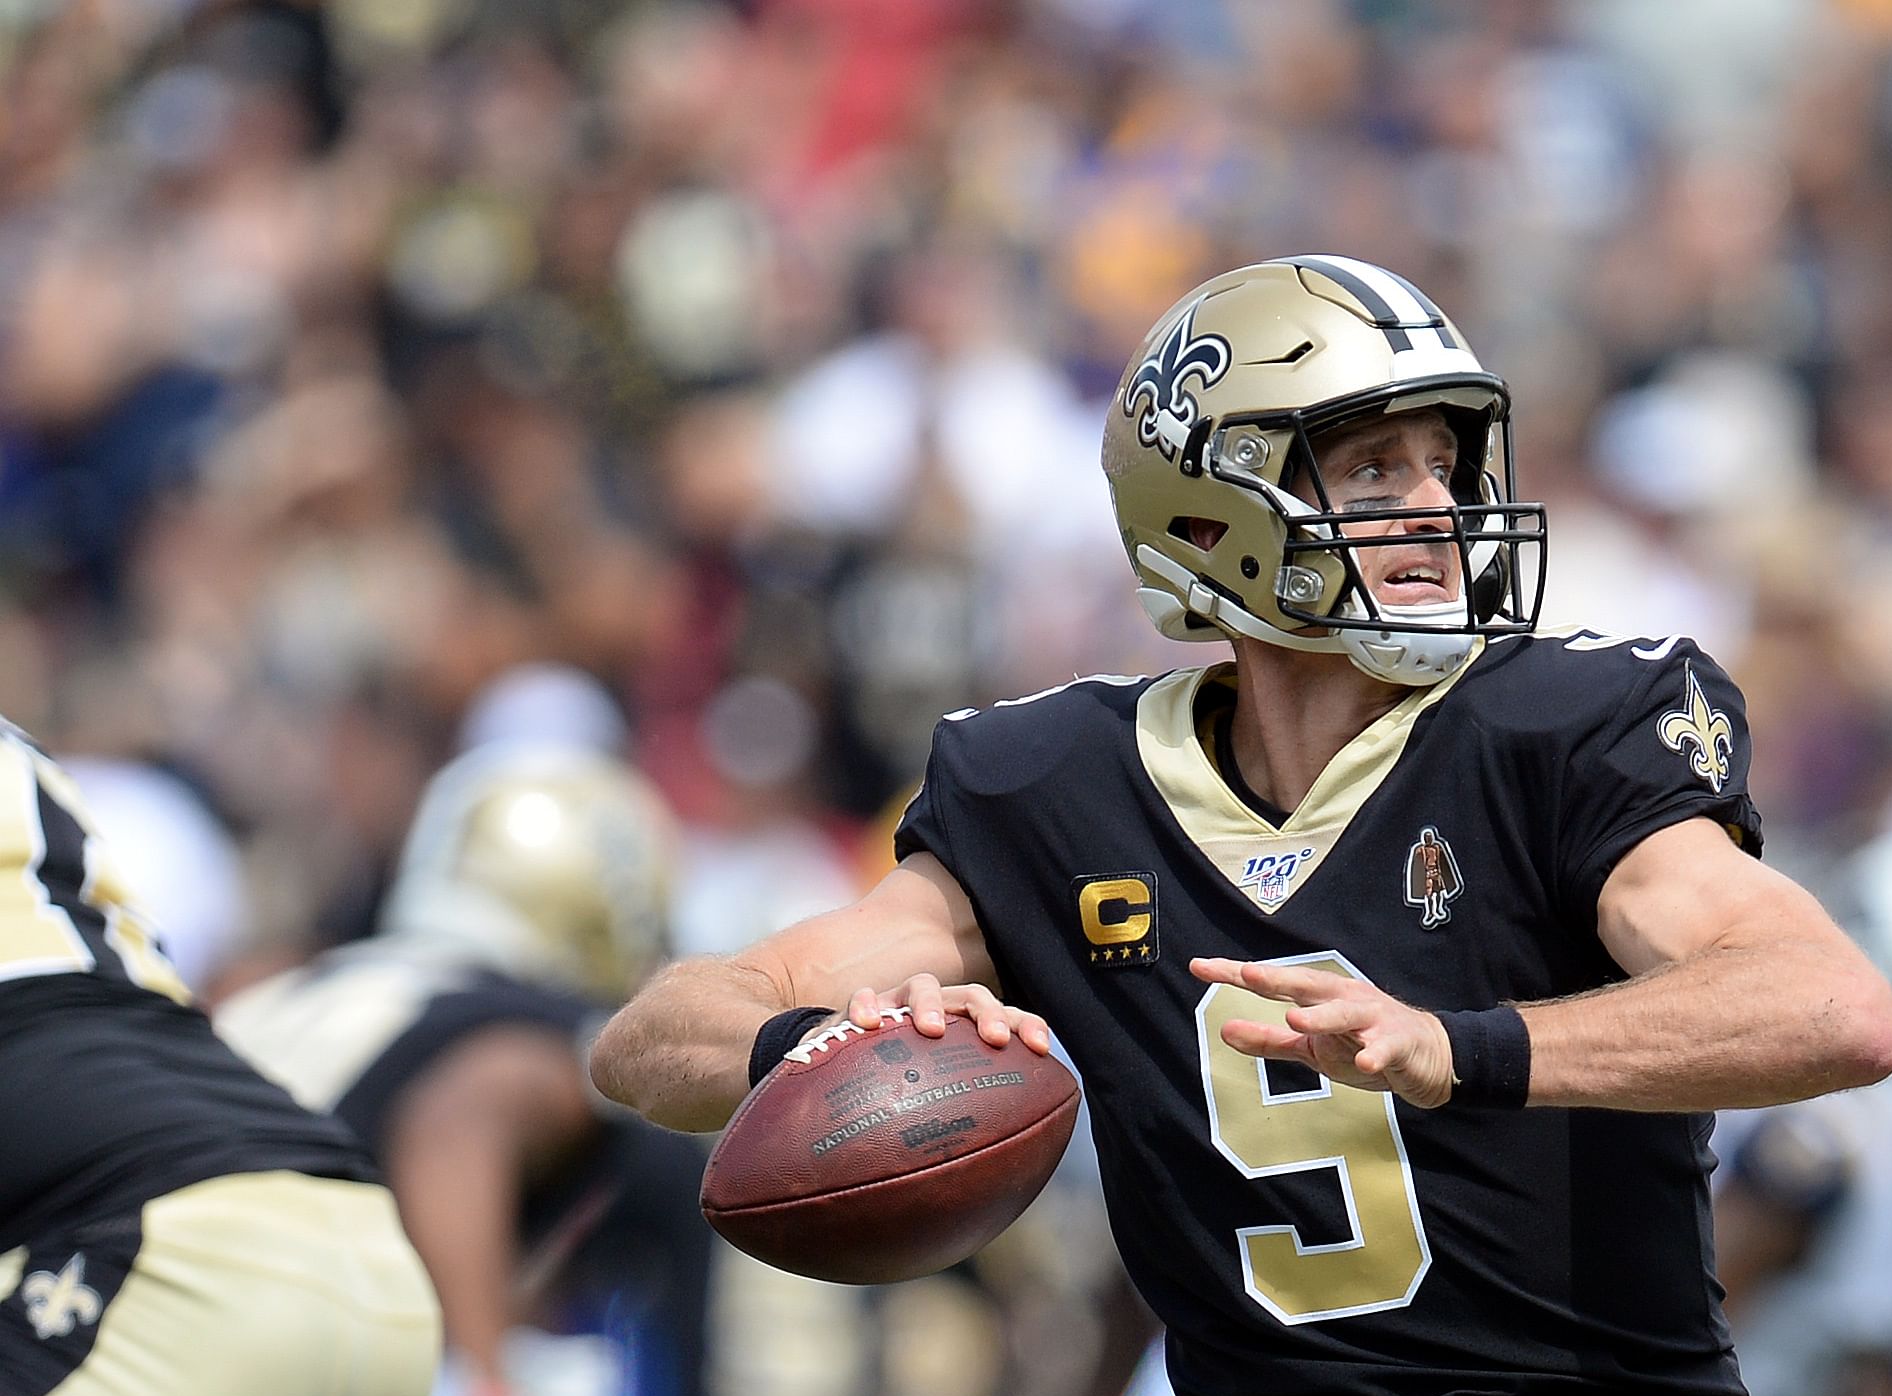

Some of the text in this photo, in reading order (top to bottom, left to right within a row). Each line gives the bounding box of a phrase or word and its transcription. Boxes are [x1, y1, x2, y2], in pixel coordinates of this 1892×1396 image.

[1078, 878, 1151, 946] C
[1263, 884, 1282, 899] NFL
[812, 1108, 890, 1155] NATIONAL
[892, 1080, 971, 1113] FOOTBALL
[973, 1071, 1025, 1090] LEAGUE
[1194, 949, 1433, 1327] 9
